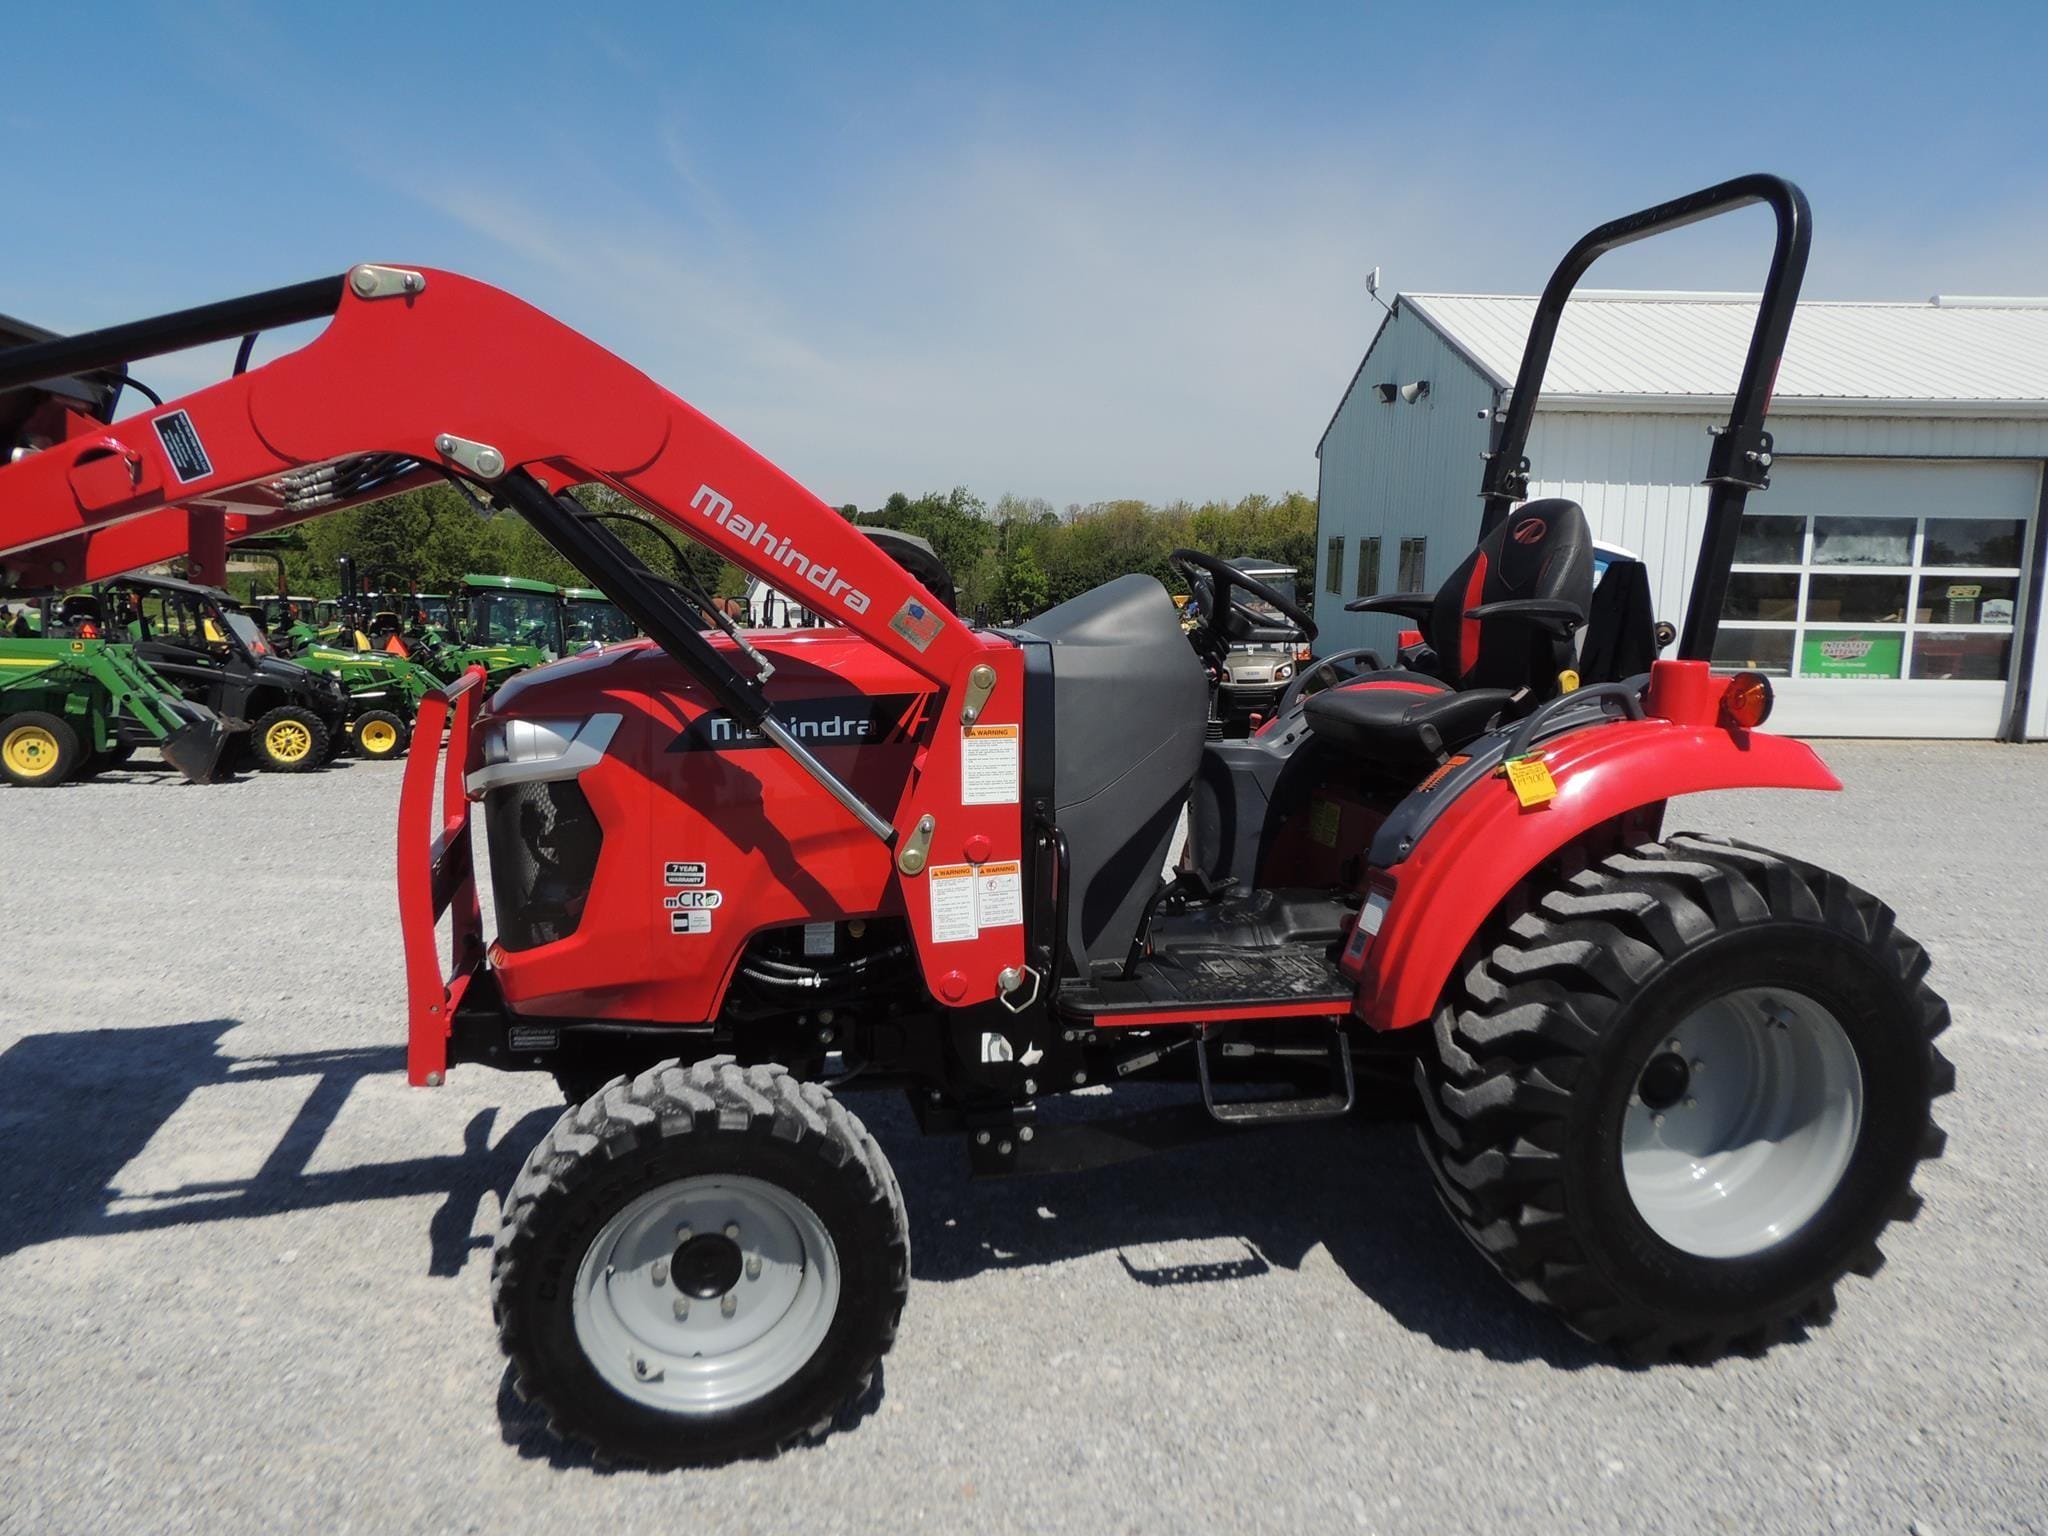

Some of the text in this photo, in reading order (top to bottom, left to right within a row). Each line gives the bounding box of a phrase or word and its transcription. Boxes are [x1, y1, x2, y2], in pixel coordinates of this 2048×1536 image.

[689, 483, 872, 615] Mahindra
[940, 868, 971, 876] WARNING
[986, 865, 1016, 873] WARNING
